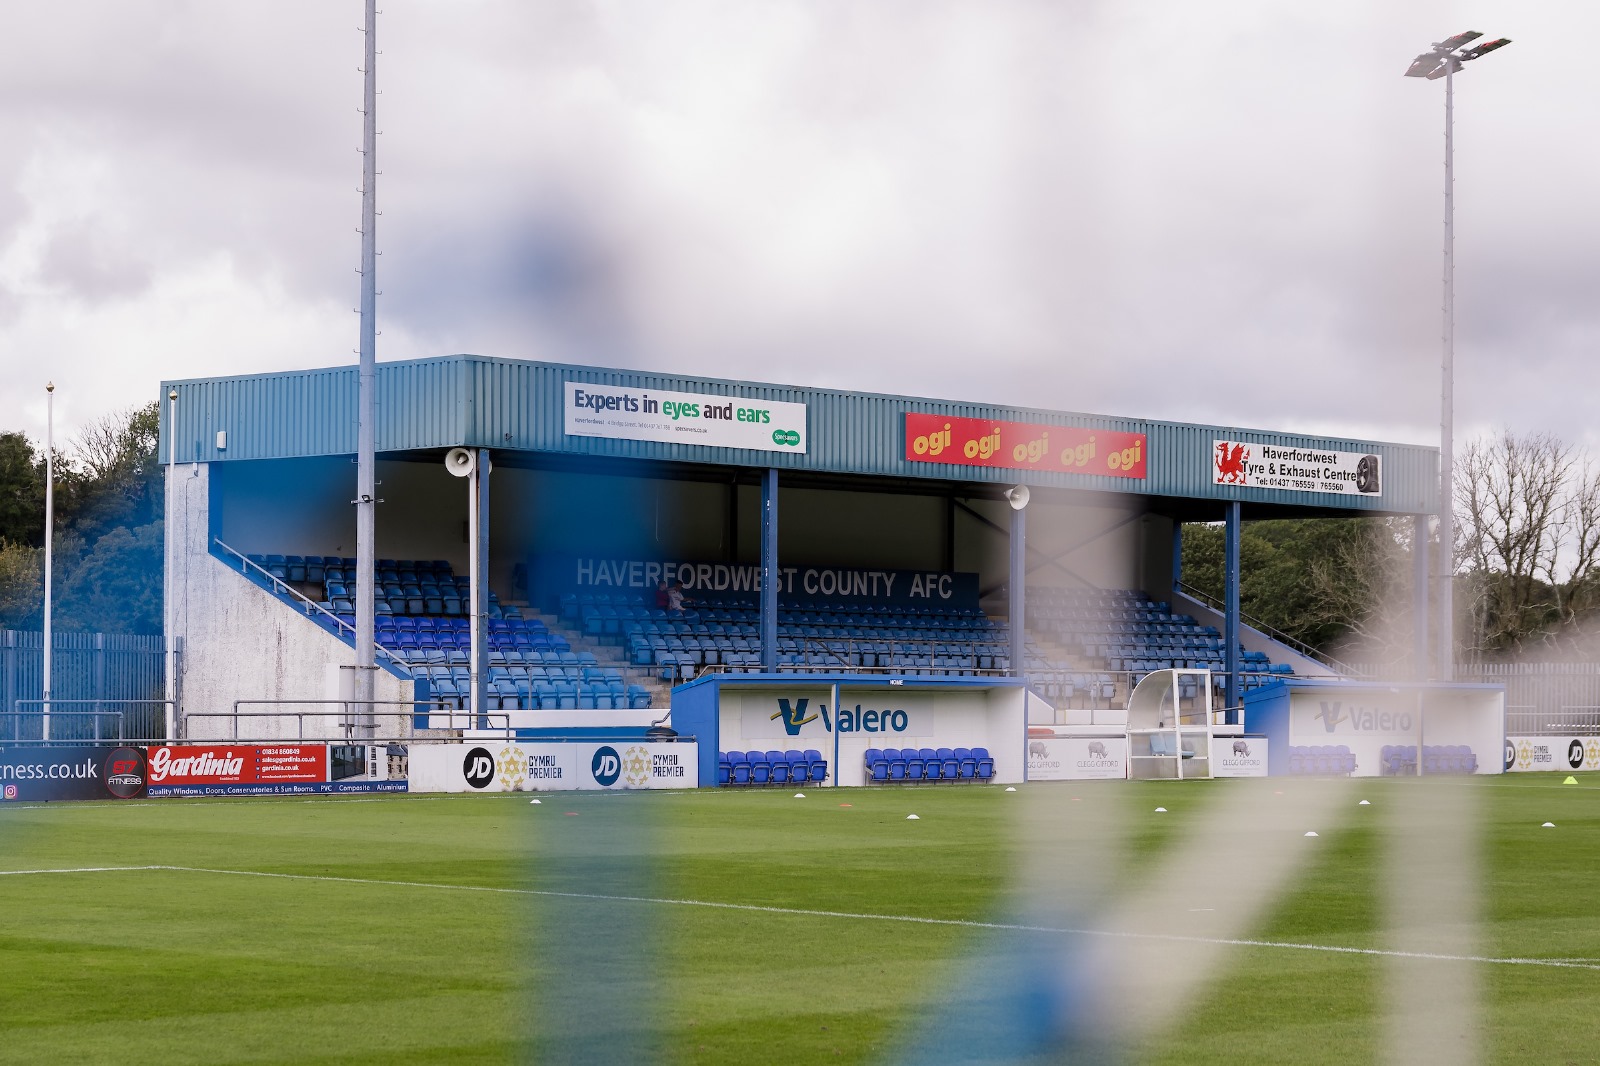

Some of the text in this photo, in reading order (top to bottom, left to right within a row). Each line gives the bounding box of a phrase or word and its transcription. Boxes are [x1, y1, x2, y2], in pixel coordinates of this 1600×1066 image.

[575, 389, 770, 424] Experts in eyes and ears
[913, 423, 1140, 470] ogi ogi ogi ogi ogi
[1262, 446, 1337, 464] Haverfordwest
[1242, 460, 1356, 482] Tyre & Exhaust Centre
[1256, 476, 1268, 486] Tel:
[1270, 478, 1290, 487] 01437
[1292, 480, 1315, 489] 765559
[1320, 482, 1344, 491] 765560
[804, 570, 896, 596] COUNTY
[910, 574, 952, 599] AFC
[820, 704, 908, 732] Valero
[1349, 706, 1412, 731] Valero
[528, 756, 556, 767] CYMRU
[653, 754, 678, 766] CYMRU
[1506, 746, 1514, 762] D
[1570, 746, 1582, 762] JD
[148, 748, 244, 782] Gardinia
[467, 756, 491, 779] JD
[528, 768, 562, 779] PREMIER
[595, 756, 618, 776] JD
[653, 766, 684, 778] PREMIER
[148, 788, 171, 796] Quality
[174, 787, 203, 795] Windows,
[206, 786, 225, 794] Doors,
[228, 785, 272, 794] Conservatories
[339, 784, 370, 792] Composite
